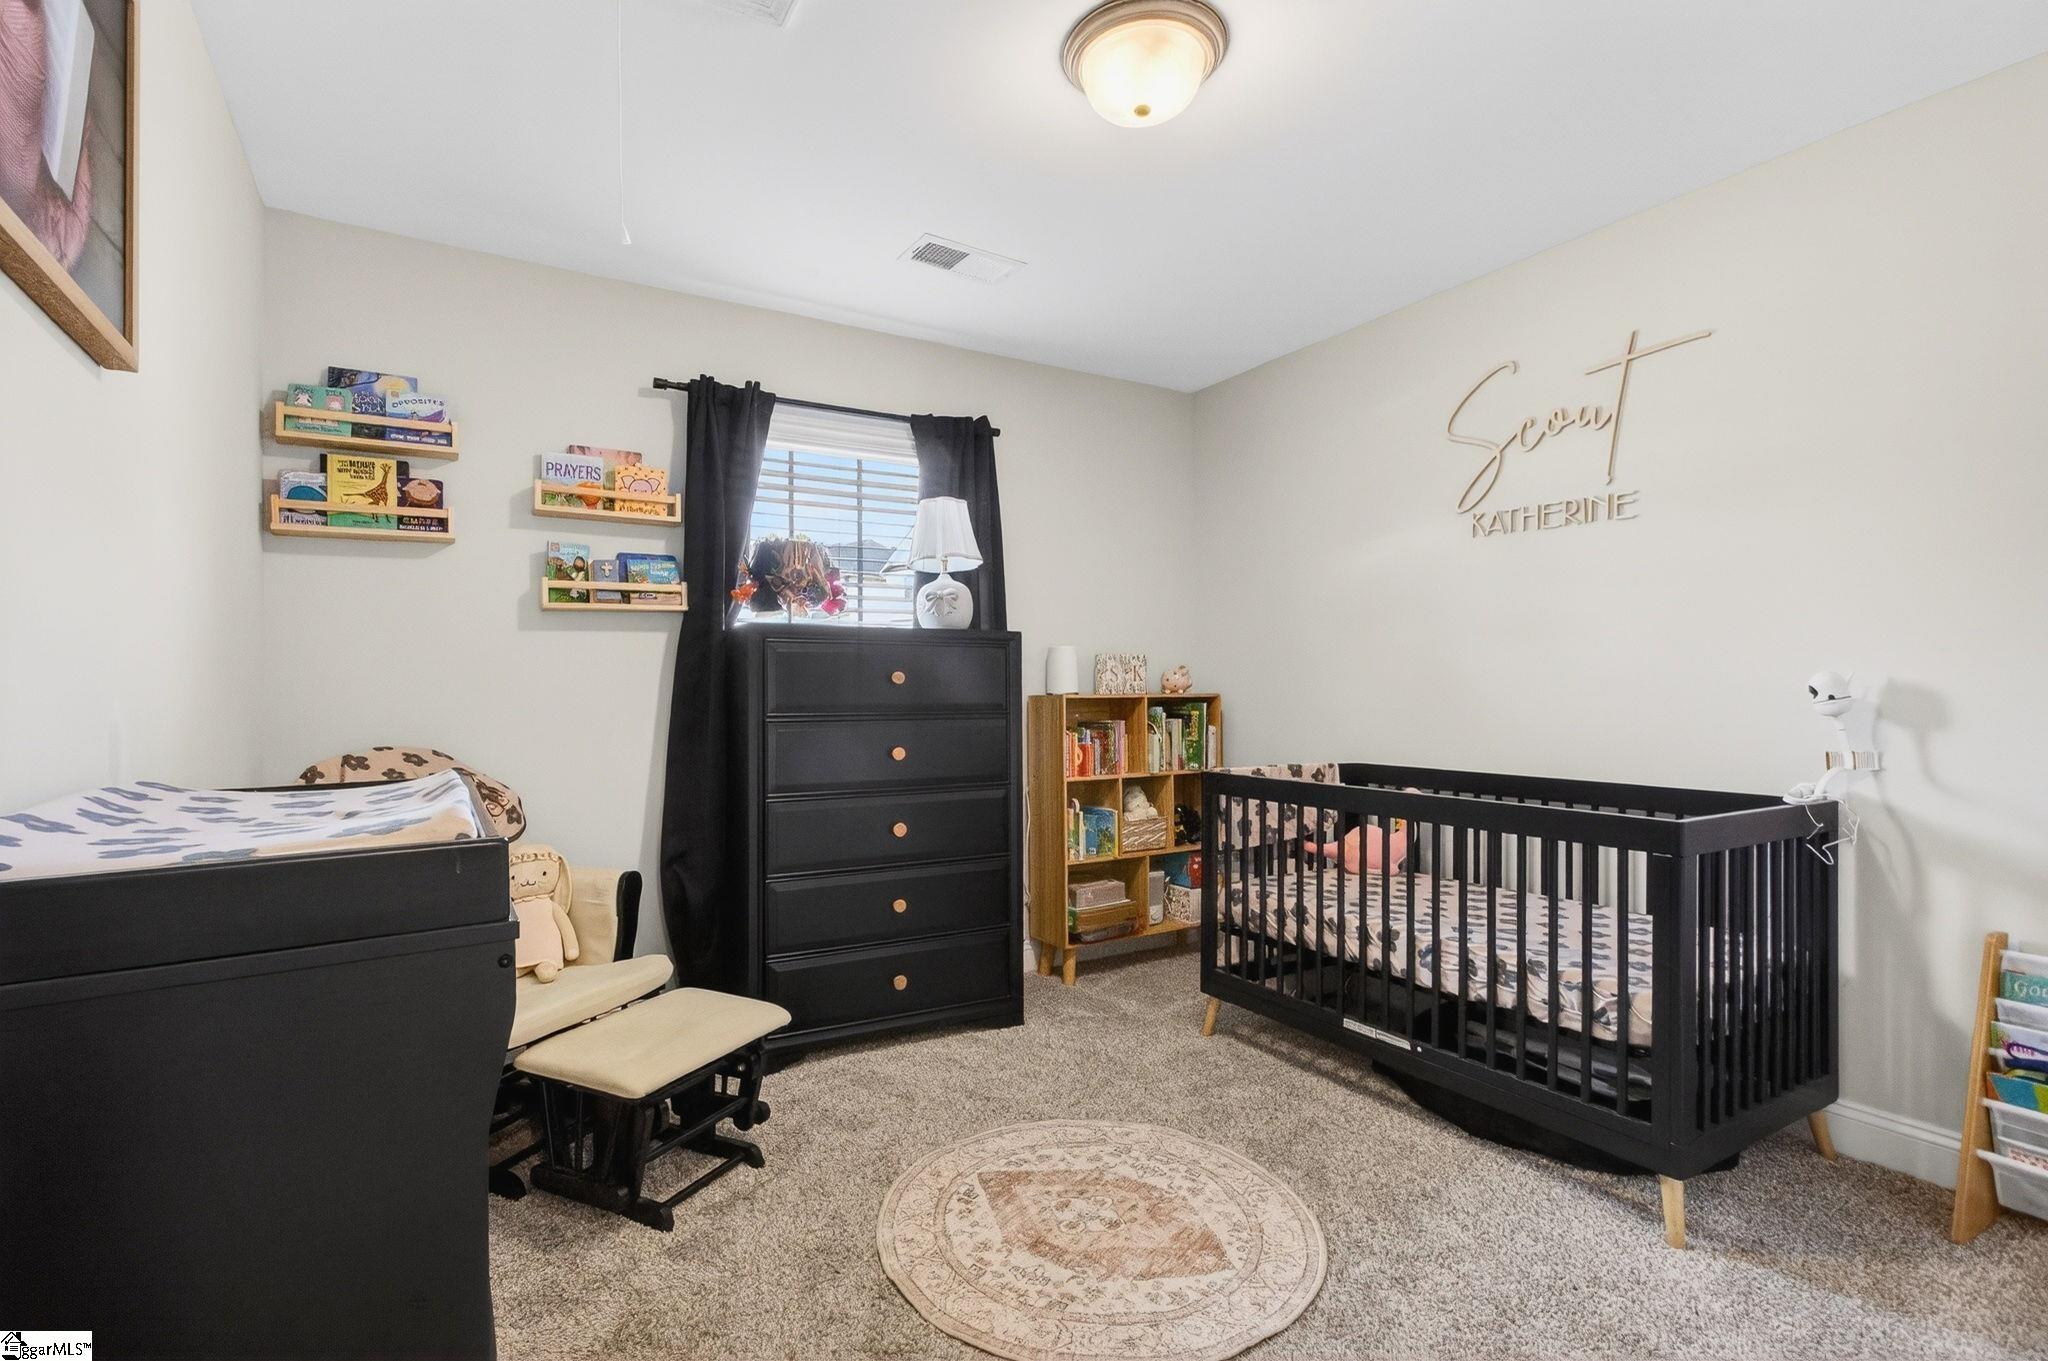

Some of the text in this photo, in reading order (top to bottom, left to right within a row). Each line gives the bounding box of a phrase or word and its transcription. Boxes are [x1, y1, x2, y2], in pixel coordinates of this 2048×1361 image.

[1448, 329, 1712, 514] Scout
[545, 461, 602, 481] PRAYERS
[1471, 490, 1641, 538] KATHERINE
